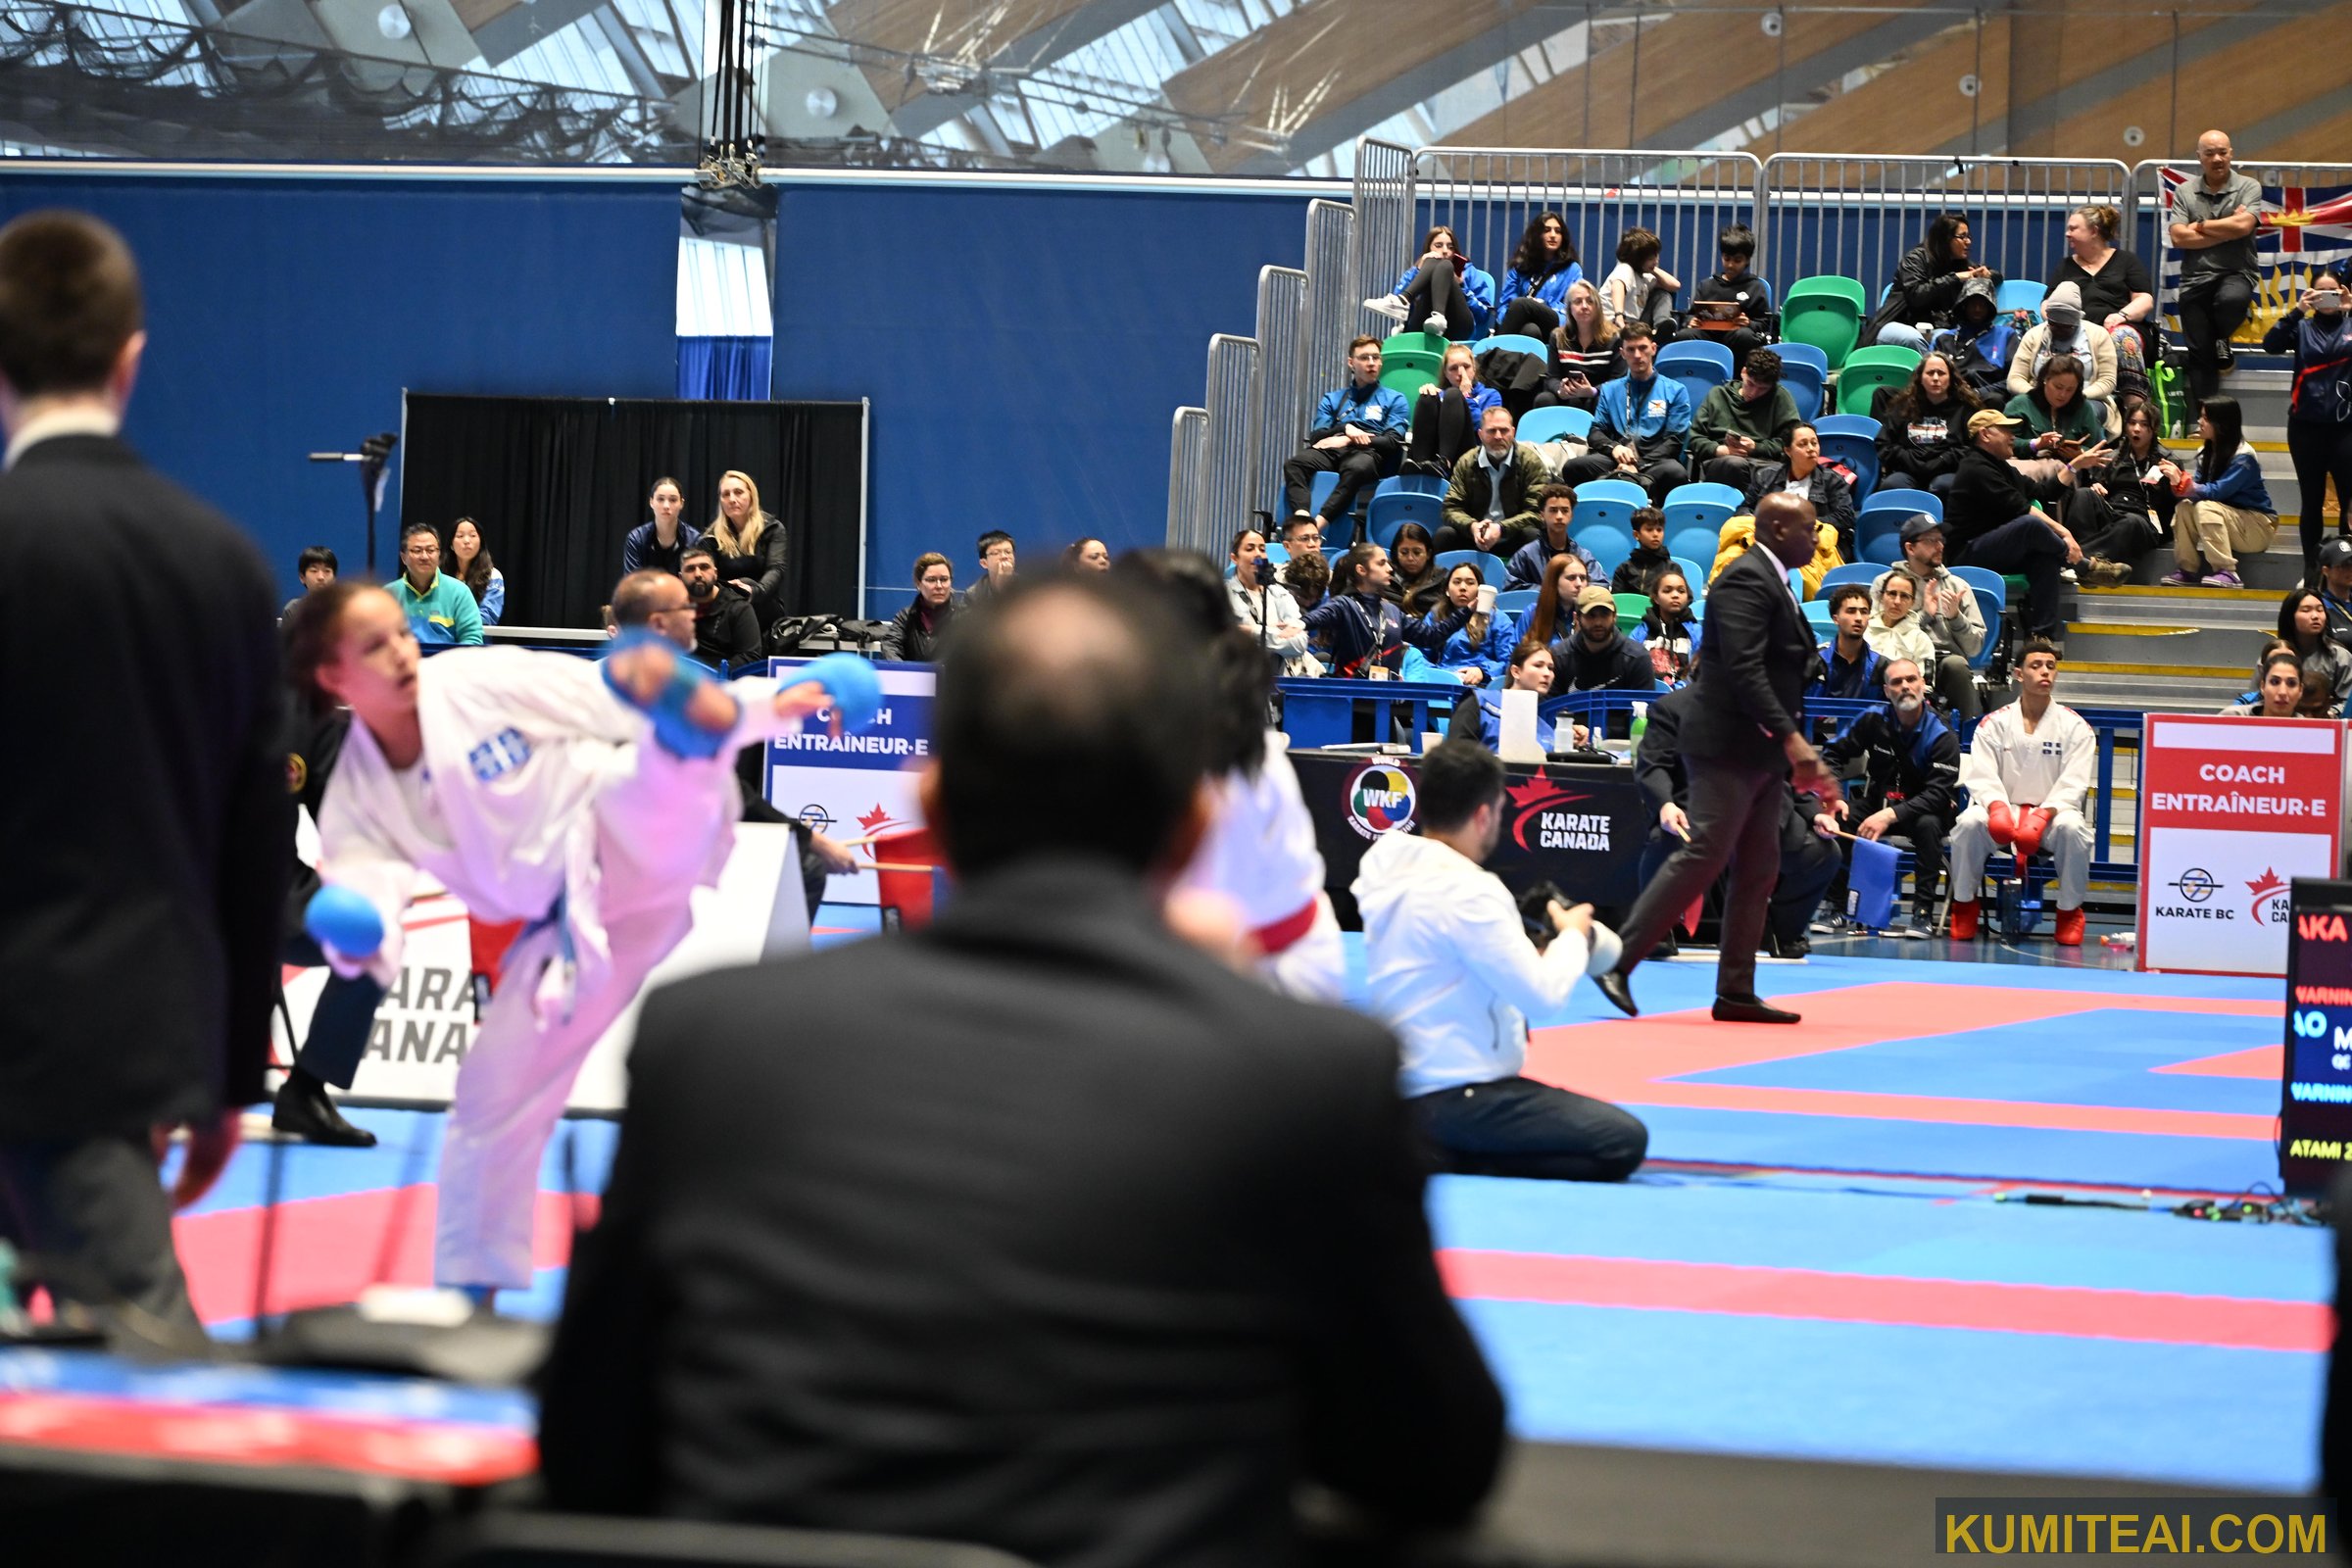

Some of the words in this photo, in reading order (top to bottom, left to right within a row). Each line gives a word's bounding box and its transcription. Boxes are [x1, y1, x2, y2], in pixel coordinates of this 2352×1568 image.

[2199, 763, 2285, 784] COACH
[1362, 789, 1402, 808] WKF
[2151, 792, 2327, 816] ENTRAÎNEUR·E
[1541, 811, 1611, 833] KARATE
[1540, 830, 1610, 852] CANADA
[2155, 906, 2212, 919] KARATE
[2216, 908, 2234, 920] BC
[2289, 1139, 2342, 1160] ATAMI
